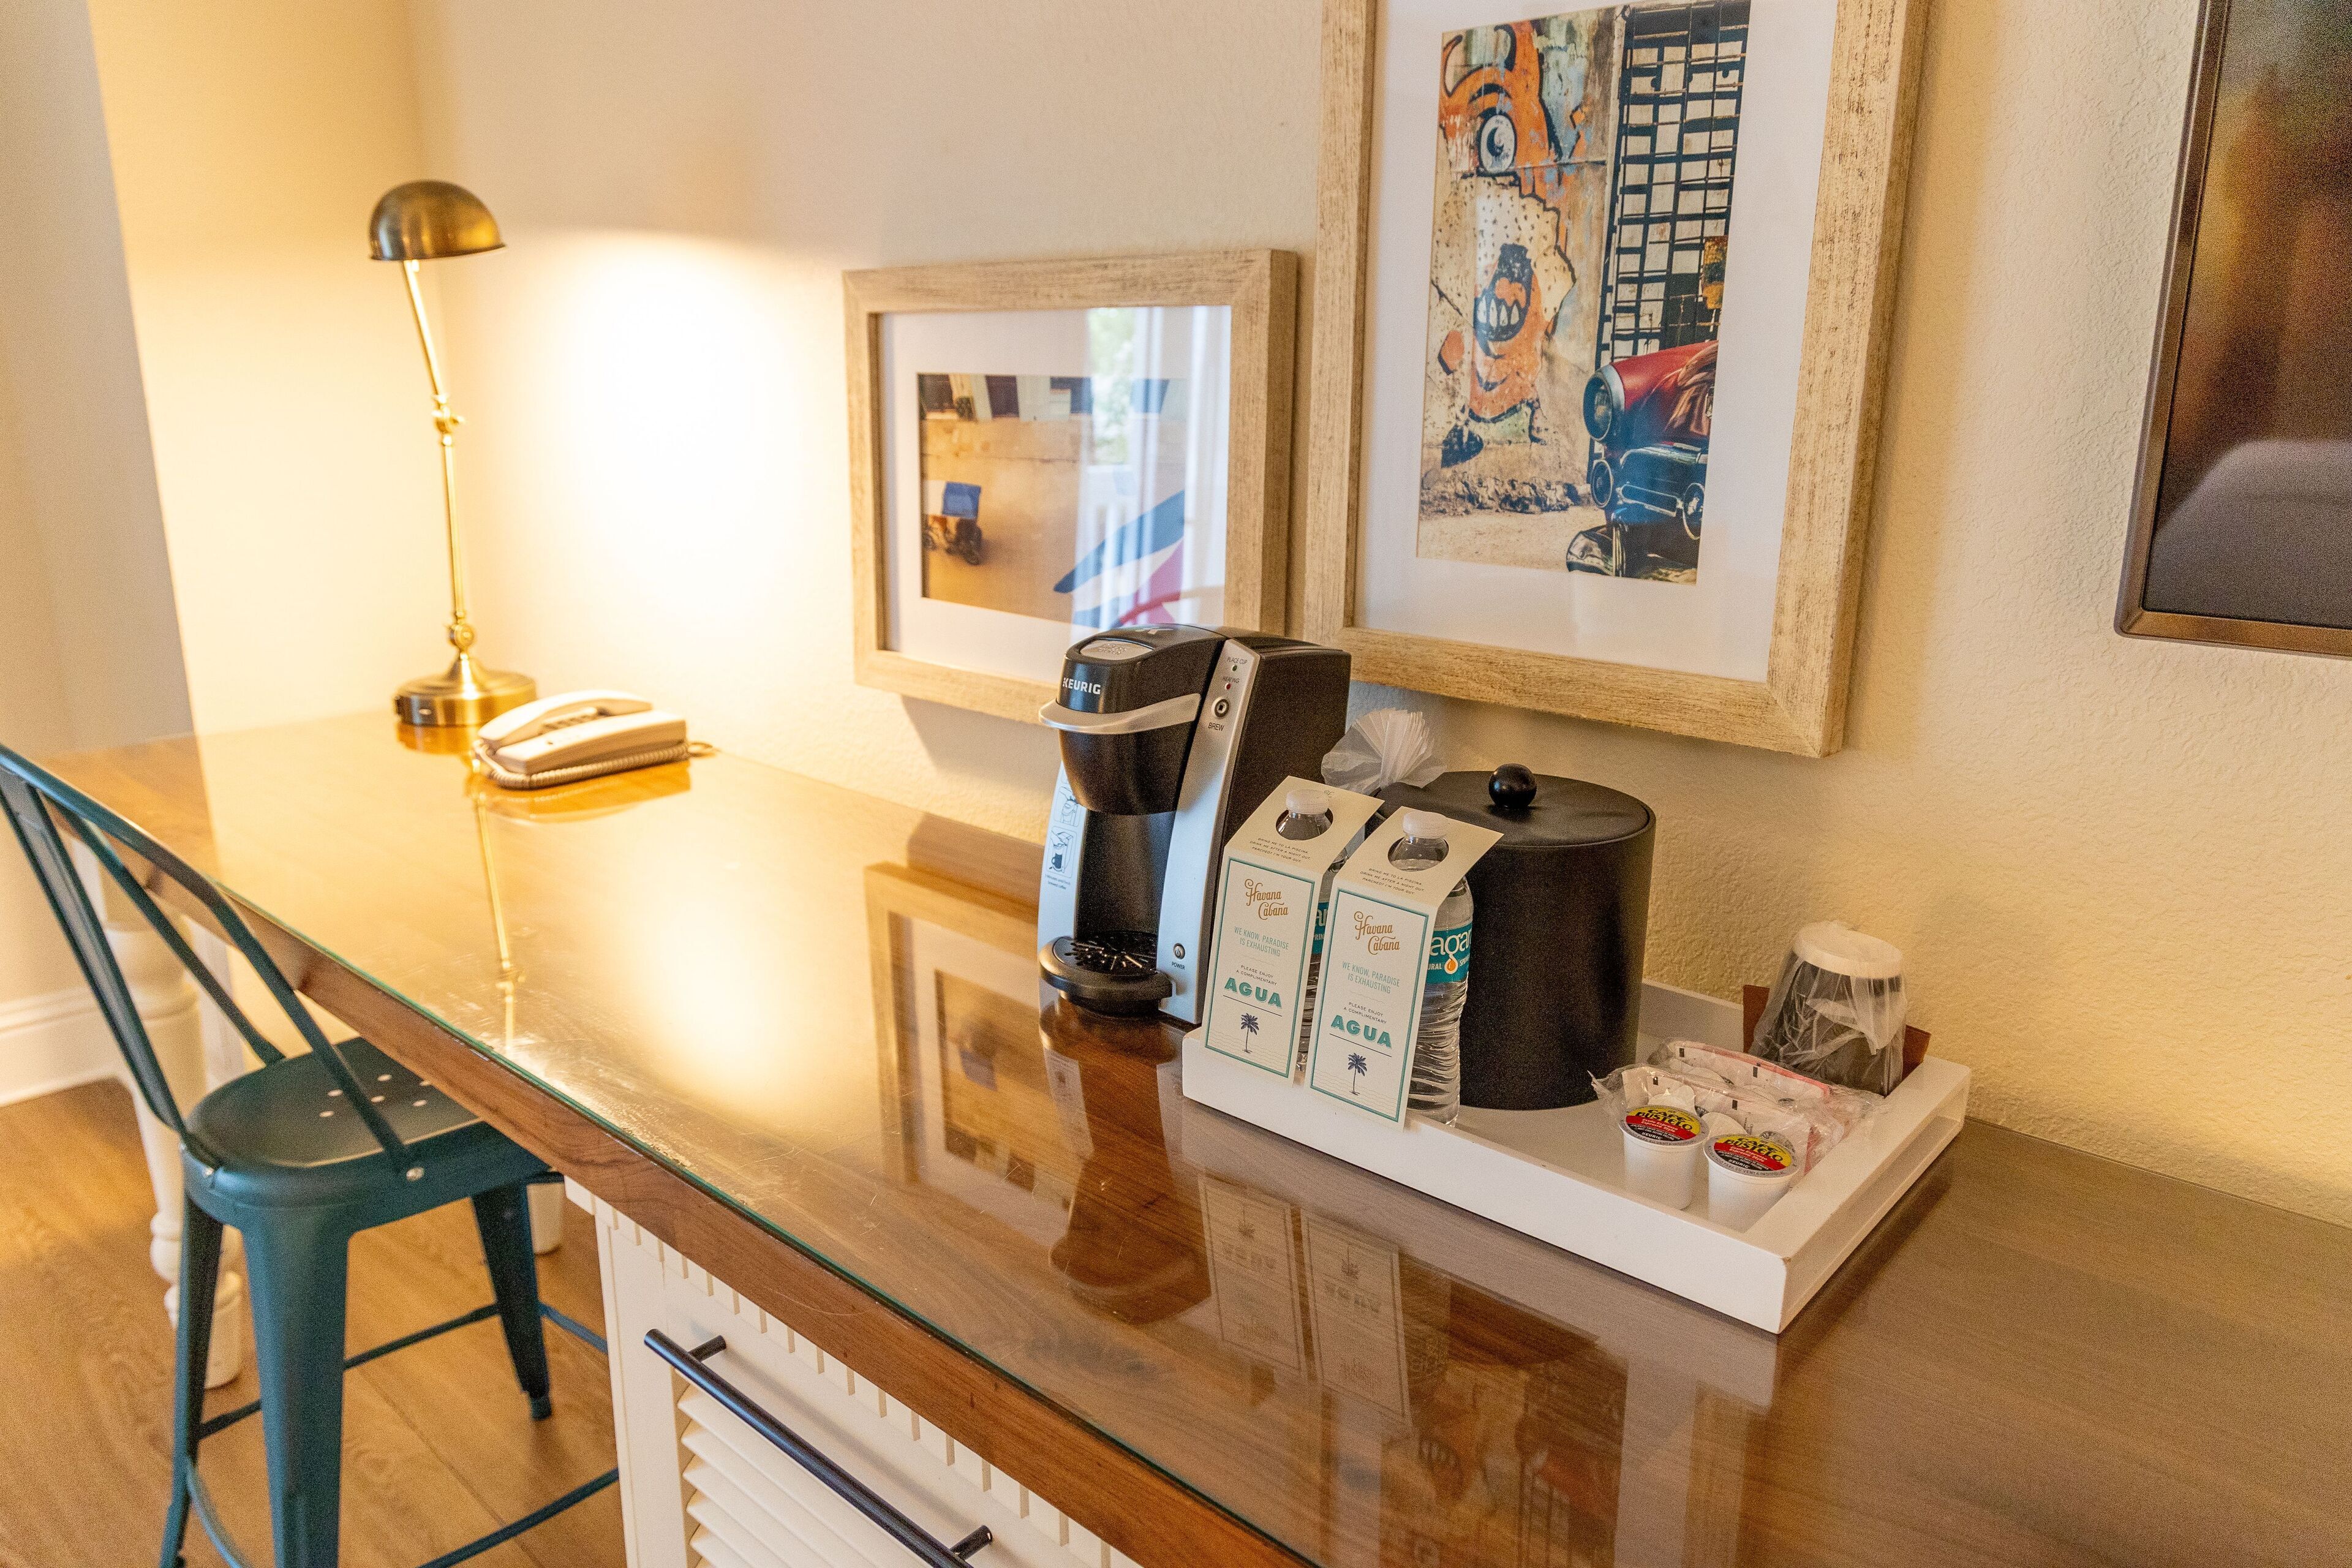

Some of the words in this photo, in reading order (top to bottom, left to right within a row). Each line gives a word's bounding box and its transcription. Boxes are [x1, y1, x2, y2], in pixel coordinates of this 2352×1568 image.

[1063, 677, 1101, 695] KEURIG
[1208, 722, 1224, 731] BREW
[1245, 878, 1282, 907] Havana
[1258, 902, 1289, 921] Cabana
[1354, 911, 1393, 940] Havana
[1234, 925, 1242, 935] WE
[1243, 929, 1261, 941] KNOW,
[1262, 935, 1289, 950] PARADISE
[1368, 935, 1401, 956] Cabana
[1246, 940, 1281, 957] EXHAUSTING
[1171, 962, 1185, 970] POWER
[1241, 965, 1257, 974] PLEASE
[1342, 961, 1351, 971] WE
[1352, 964, 1370, 977] KNOW,
[1372, 971, 1401, 987] PARADISE
[1240, 971, 1277, 986] COMPLIMENTARY
[1348, 973, 1354, 981] IS
[1355, 975, 1391, 994] EXHAUSTING
[1224, 977, 1283, 1008] AGUA
[1348, 1008, 1387, 1024] COMPLIMENTARY
[1349, 1001, 1366, 1011] PLEASE
[1368, 1008, 1384, 1017] ENJOY
[1330, 1014, 1392, 1049] AGUA
[1635, 1112, 1693, 1131] BUSTELO
[1724, 1139, 1783, 1161] BUSTELO
[1728, 1159, 1750, 1169] KEURIG
